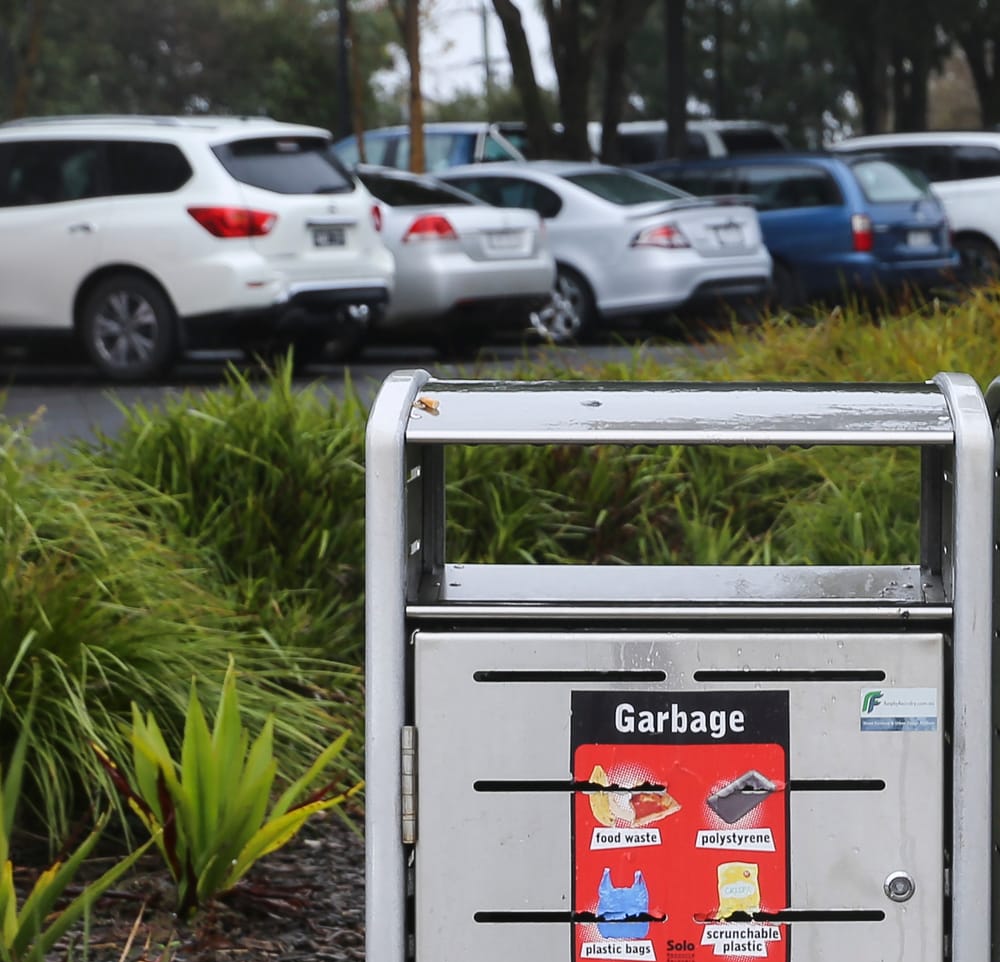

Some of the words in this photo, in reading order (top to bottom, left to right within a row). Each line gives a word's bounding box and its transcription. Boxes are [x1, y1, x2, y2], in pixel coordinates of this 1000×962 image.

[615, 703, 745, 738] Garbage
[596, 832, 621, 844] food
[624, 832, 657, 843] waste
[701, 833, 770, 845] polystyrene
[706, 928, 779, 939] scrunchable
[585, 943, 621, 955] plastic
[625, 943, 651, 955] bags
[667, 940, 695, 951] Solo
[723, 940, 762, 953] plastic
